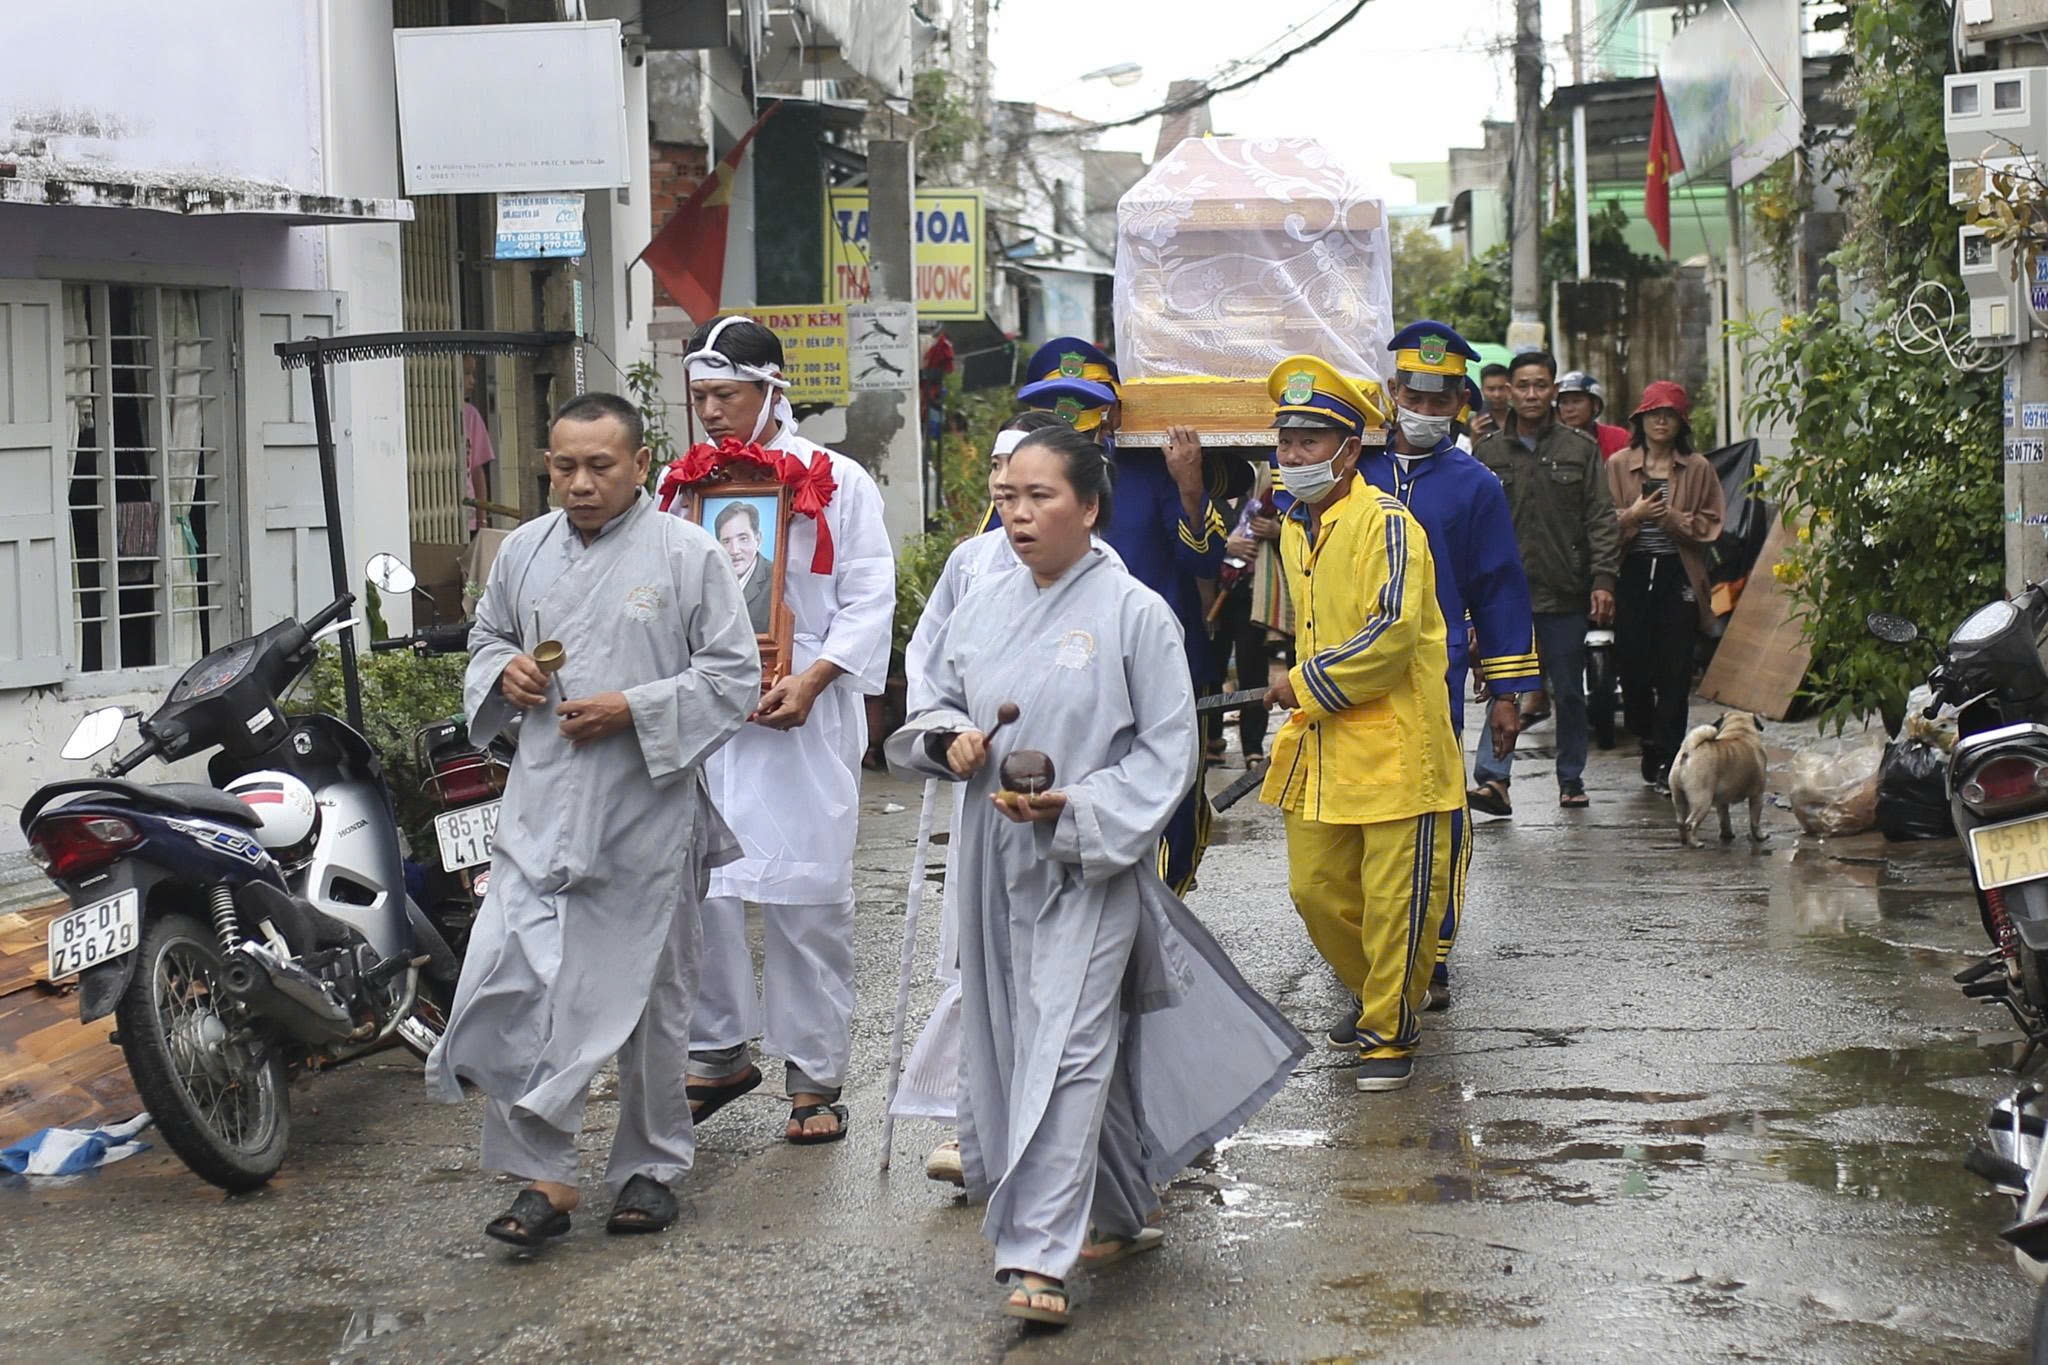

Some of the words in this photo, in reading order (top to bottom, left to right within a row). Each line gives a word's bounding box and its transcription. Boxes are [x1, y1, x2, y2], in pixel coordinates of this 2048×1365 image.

[338, 818, 369, 838] HONDA
[1987, 820, 2048, 854] 85-B
[456, 834, 493, 864] 416
